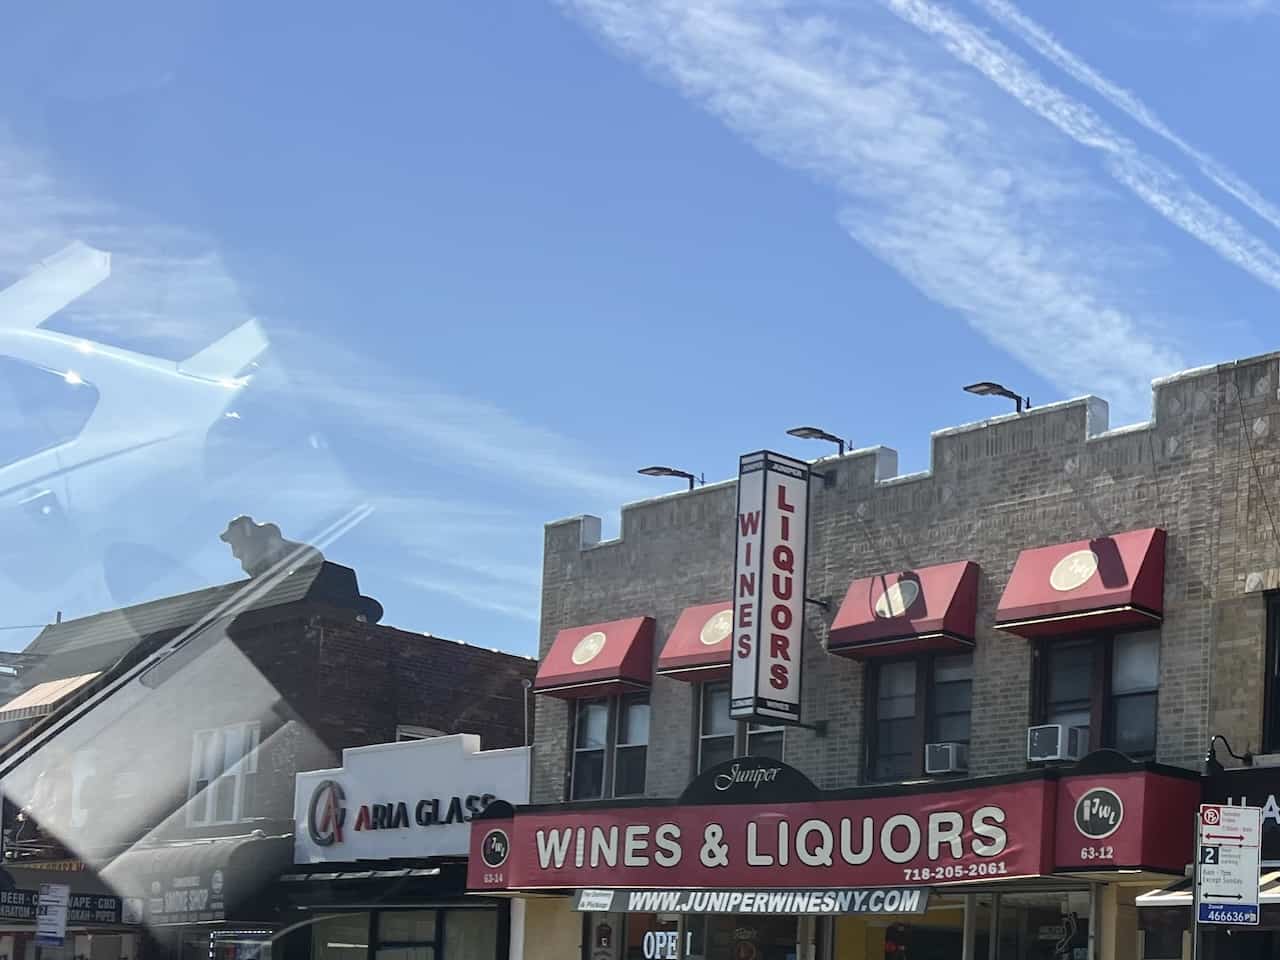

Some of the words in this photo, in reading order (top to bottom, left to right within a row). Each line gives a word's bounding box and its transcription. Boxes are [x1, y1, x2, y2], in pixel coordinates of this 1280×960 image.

[738, 511, 760, 659] WINES
[770, 484, 794, 690] LIQUORS
[354, 802, 410, 831] ARIA
[536, 822, 683, 869] WINES
[700, 823, 729, 868] &
[746, 805, 1008, 867] LIQUORS
[1205, 848, 1215, 863] 2
[903, 861, 1008, 882] 718-205-2061
[627, 890, 921, 914] WWW.JUNIPERWINESNY.COM
[1207, 911, 1244, 921] 466636
